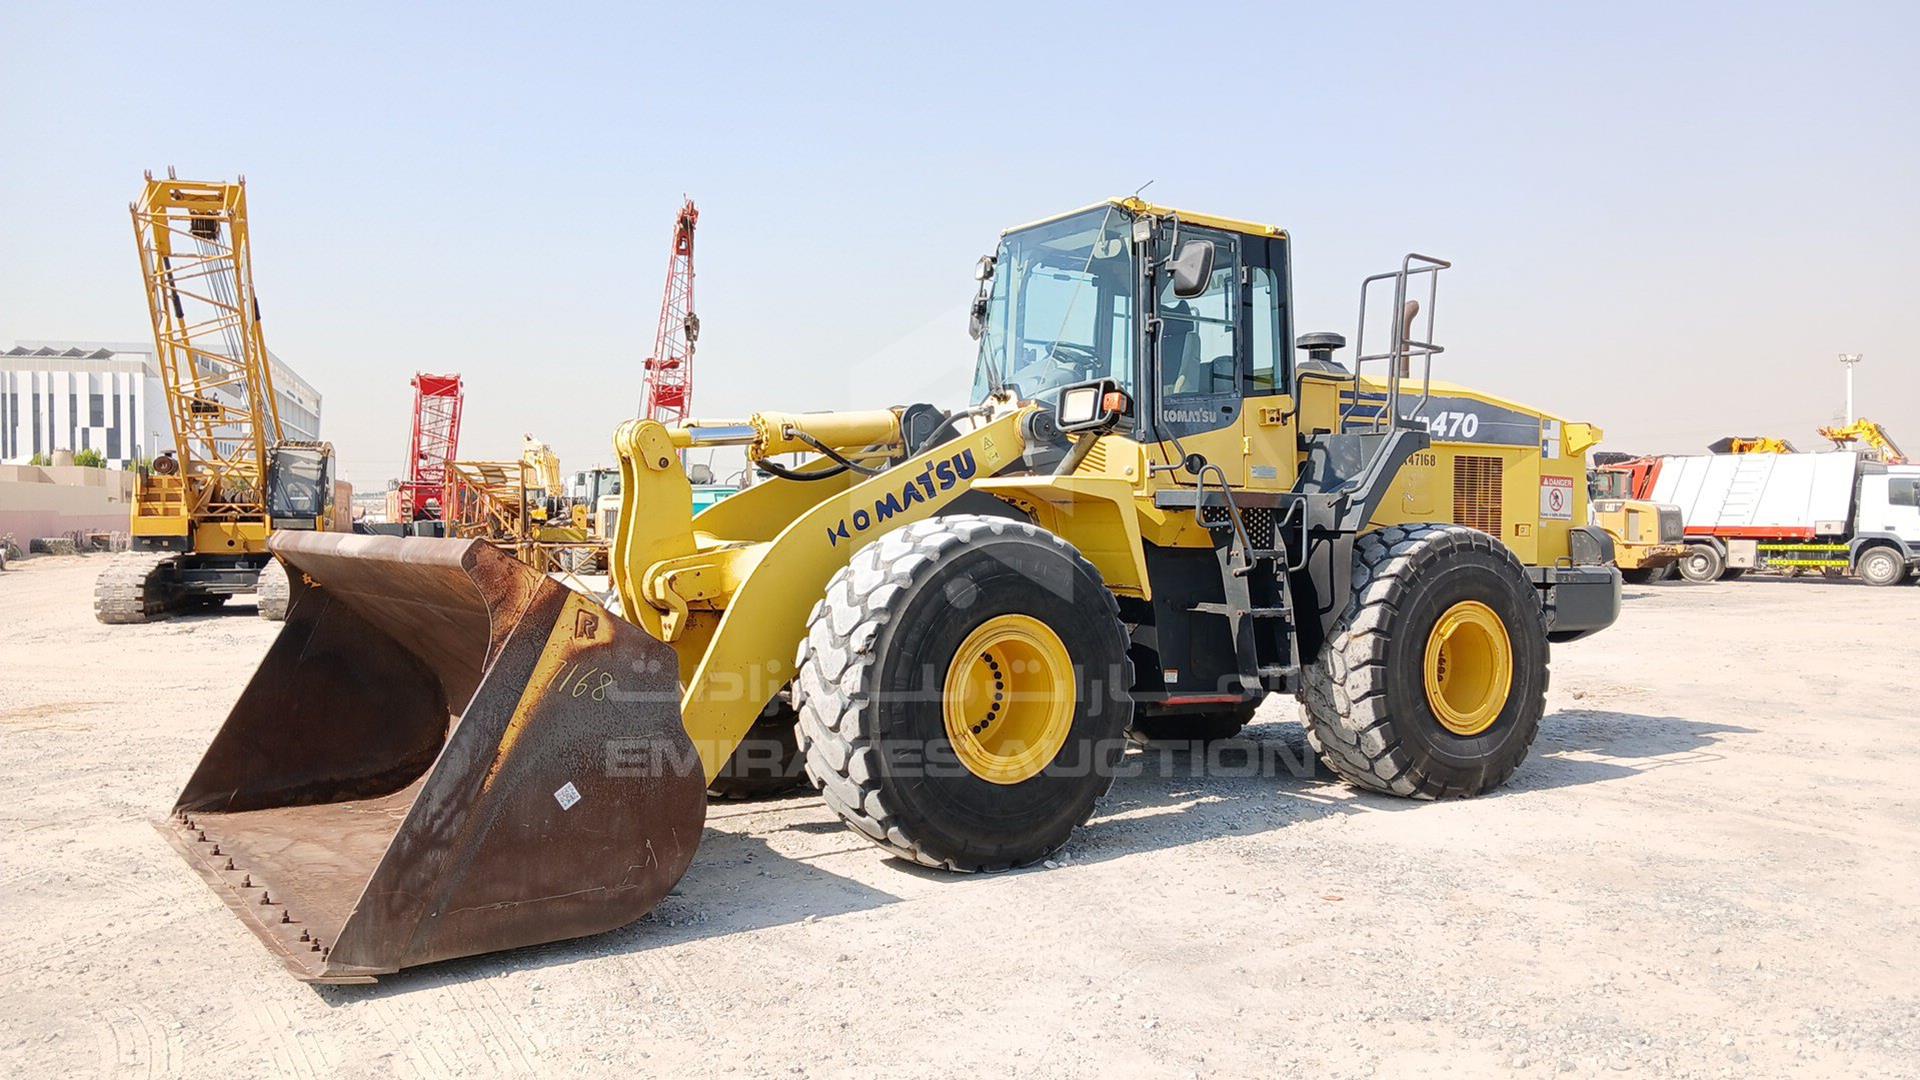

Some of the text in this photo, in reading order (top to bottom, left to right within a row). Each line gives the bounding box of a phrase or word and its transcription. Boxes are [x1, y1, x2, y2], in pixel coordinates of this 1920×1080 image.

[1405, 453, 1436, 467] 47168
[827, 447, 977, 547] KOMATSU
[1604, 502, 1616, 512] CAT
[574, 608, 600, 640] R
